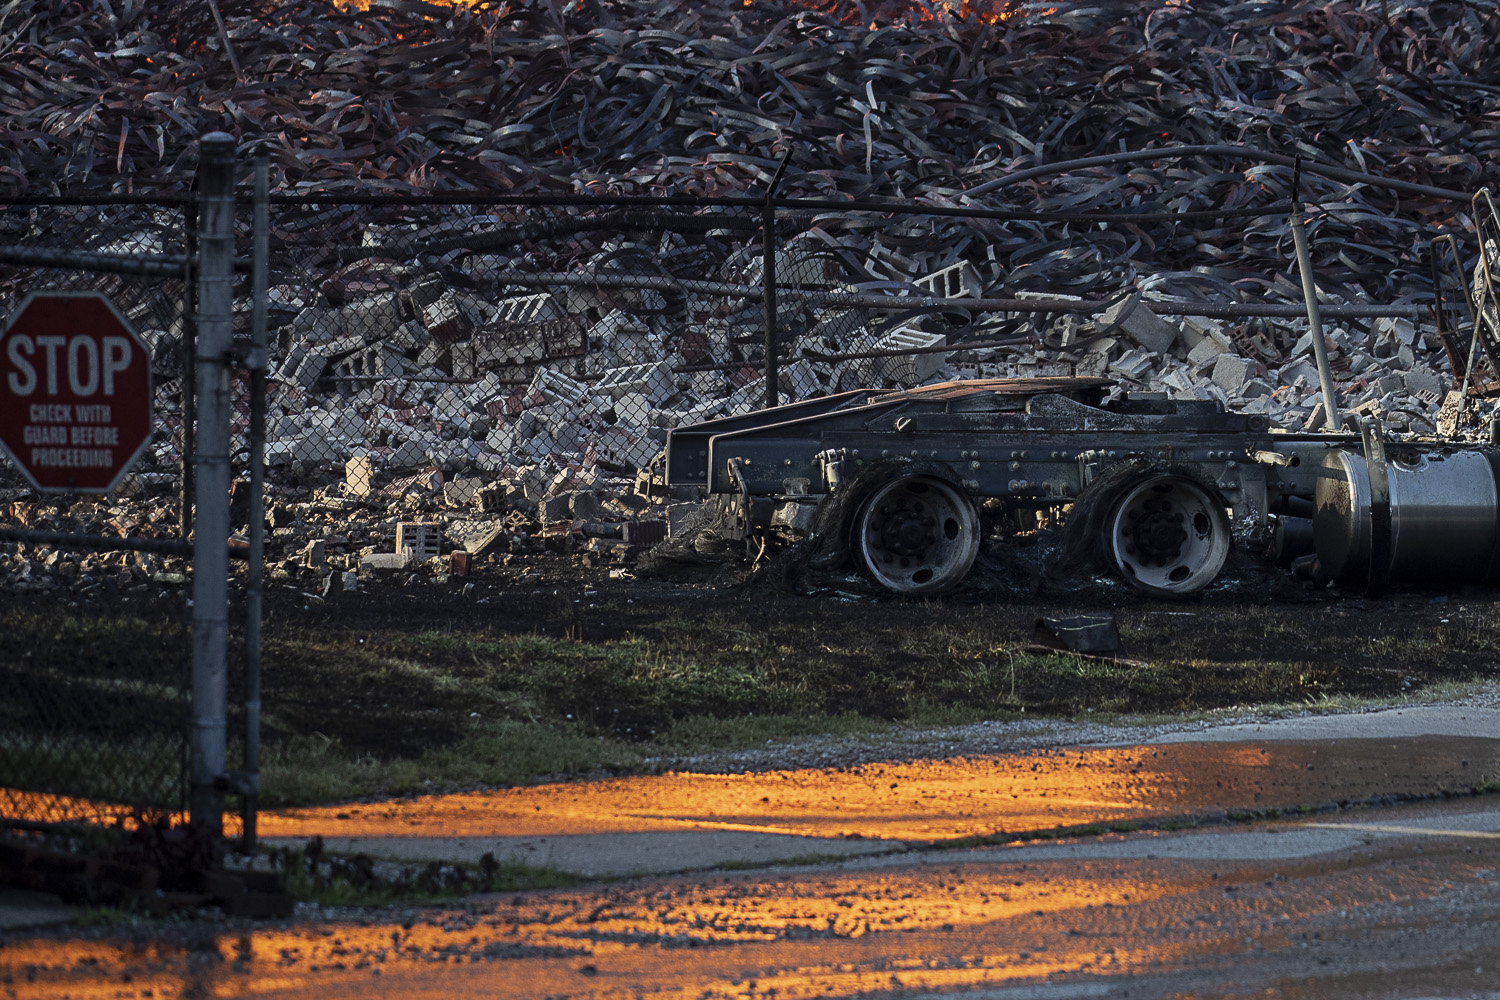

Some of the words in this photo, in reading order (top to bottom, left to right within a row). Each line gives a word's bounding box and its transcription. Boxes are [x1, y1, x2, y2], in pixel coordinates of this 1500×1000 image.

[7, 334, 132, 396] STOP
[30, 404, 72, 422] CHECK
[76, 404, 111, 423] WITH
[24, 425, 67, 444] GUARD
[71, 426, 119, 445] BEFORE
[32, 448, 113, 467] PROCEEDING
